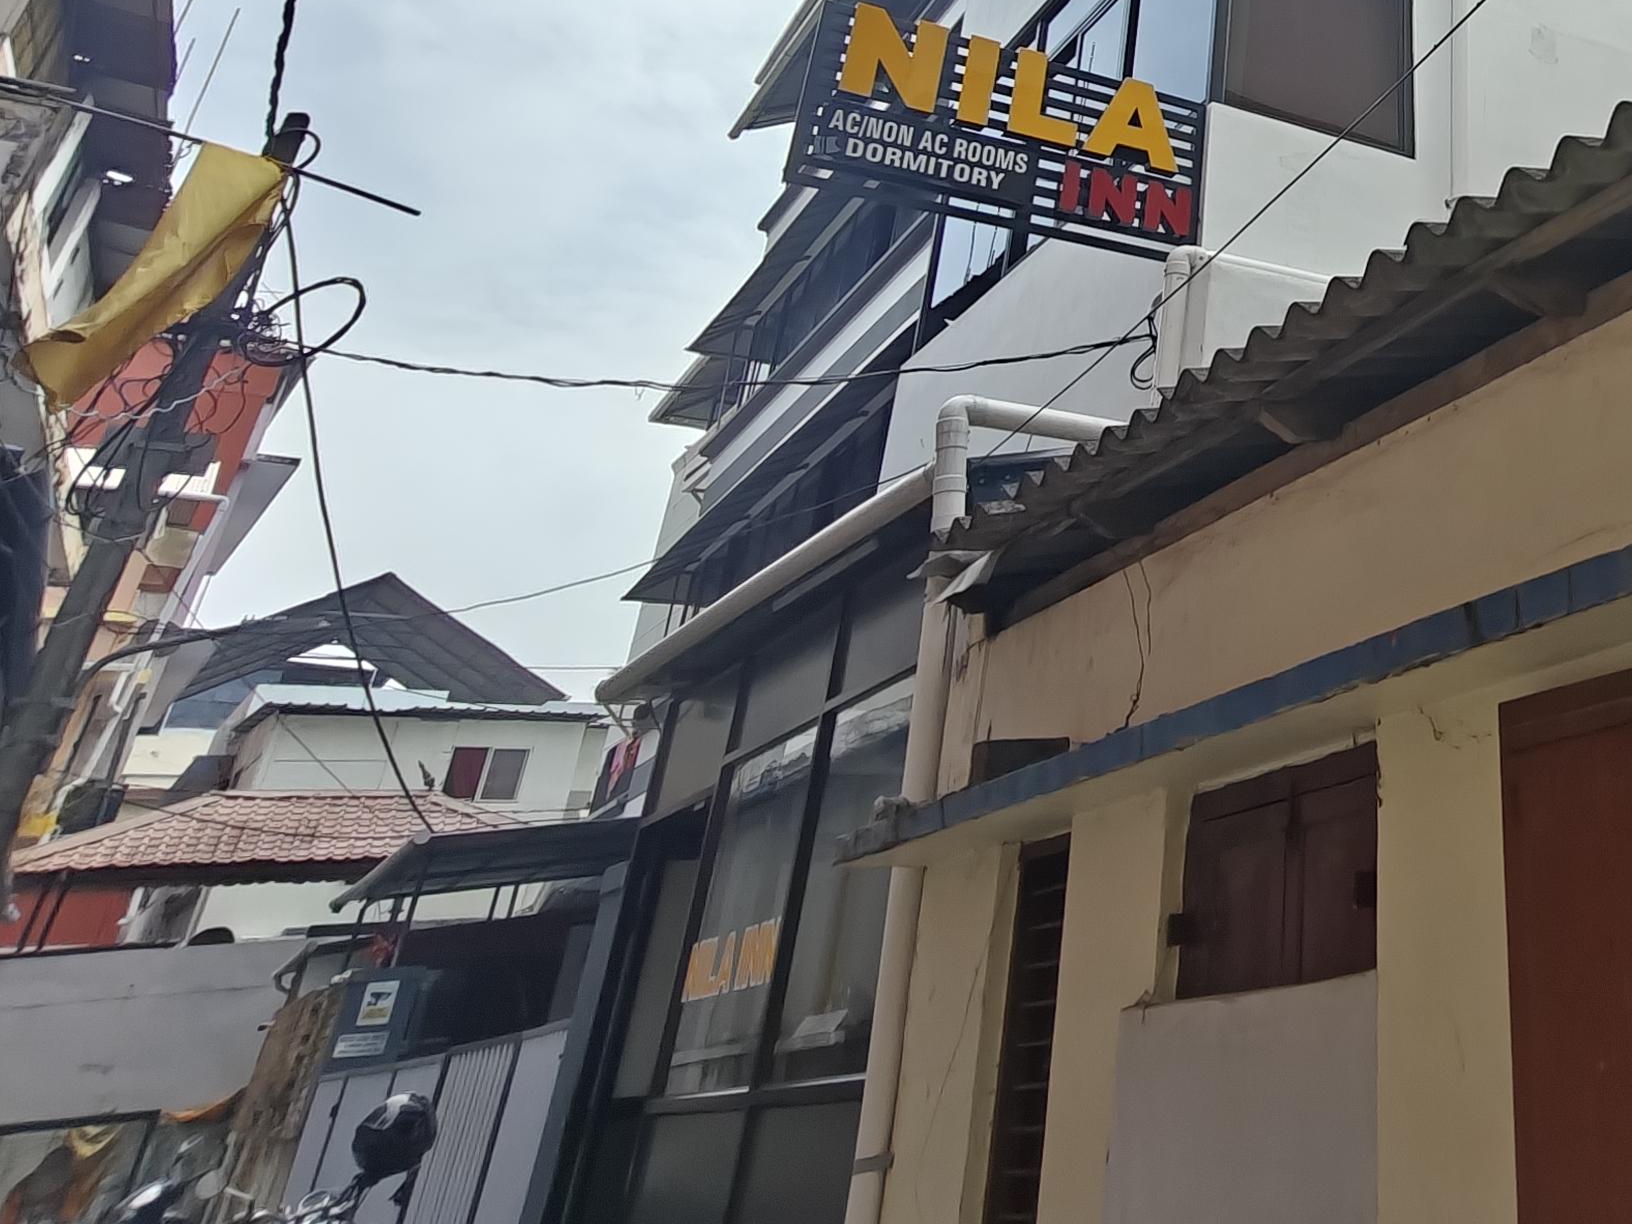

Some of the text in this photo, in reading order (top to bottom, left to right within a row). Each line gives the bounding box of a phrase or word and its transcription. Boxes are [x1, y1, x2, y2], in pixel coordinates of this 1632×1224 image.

[838, 2, 1179, 173] NILA
[828, 109, 1029, 173] AC/NON AC ROOMS
[845, 138, 1005, 190] DORMITORY
[1059, 159, 1192, 237] INN
